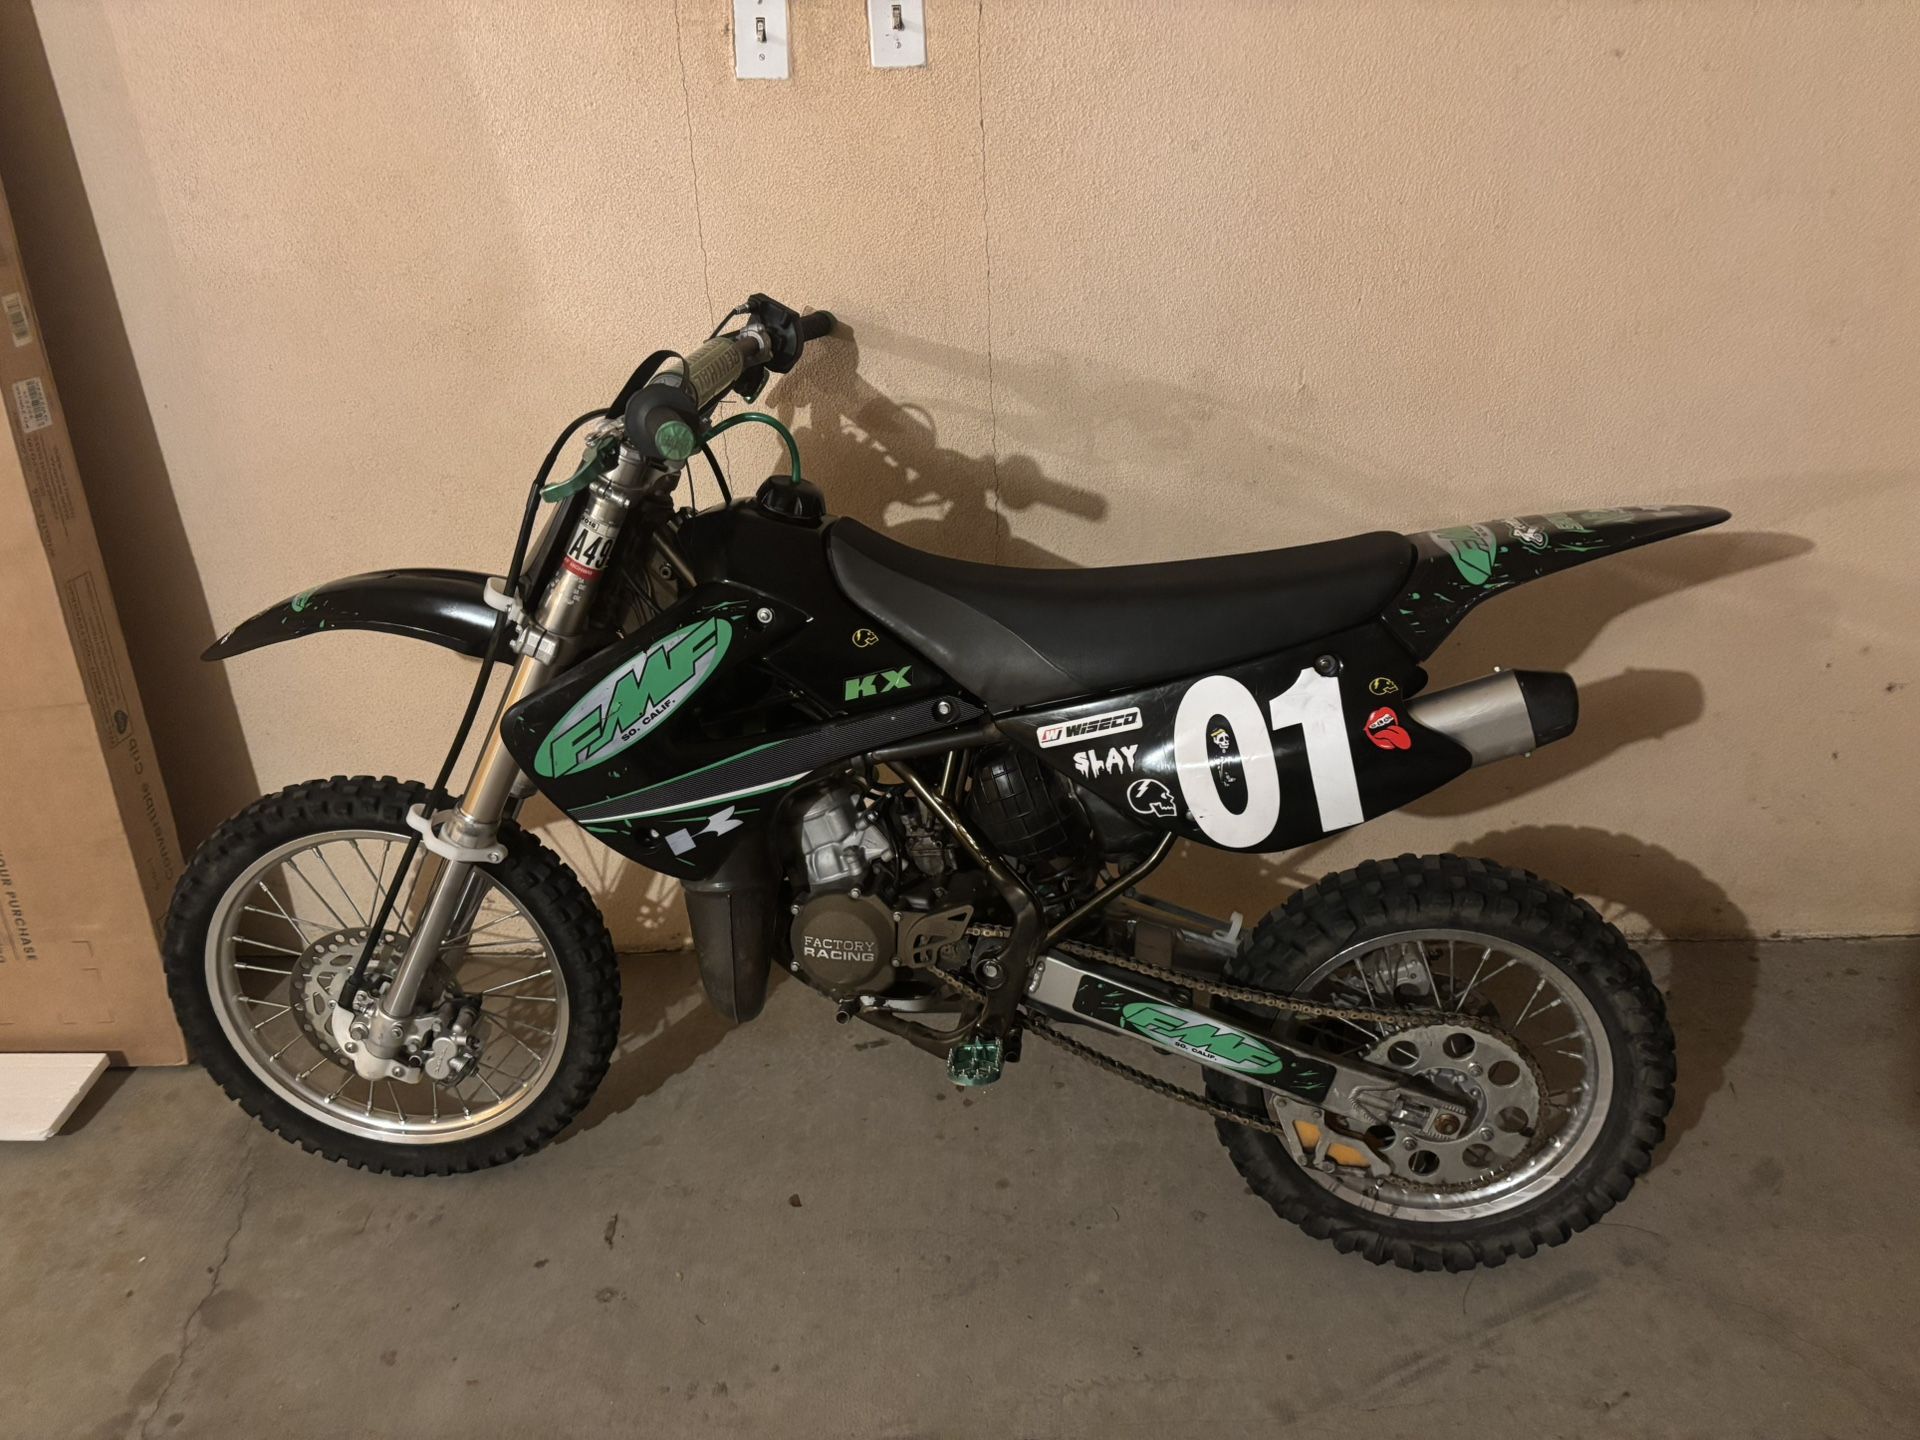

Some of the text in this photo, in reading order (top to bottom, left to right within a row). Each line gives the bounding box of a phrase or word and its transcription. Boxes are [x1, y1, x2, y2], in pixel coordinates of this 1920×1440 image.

[551, 616, 718, 779] FMF
[845, 665, 912, 701] KX
[621, 699, 676, 742] SO. CALIF.
[128, 738, 144, 775] Crib
[1073, 744, 1139, 779] SLAY
[1174, 667, 1365, 849] 01
[142, 782, 174, 881] Convertible
[5, 891, 38, 960] PURCHASE
[803, 935, 875, 951] FACTORY
[803, 946, 875, 962] RACING
[1125, 1006, 1281, 1067] FMF
[1191, 1047, 1217, 1061] CALIF.
